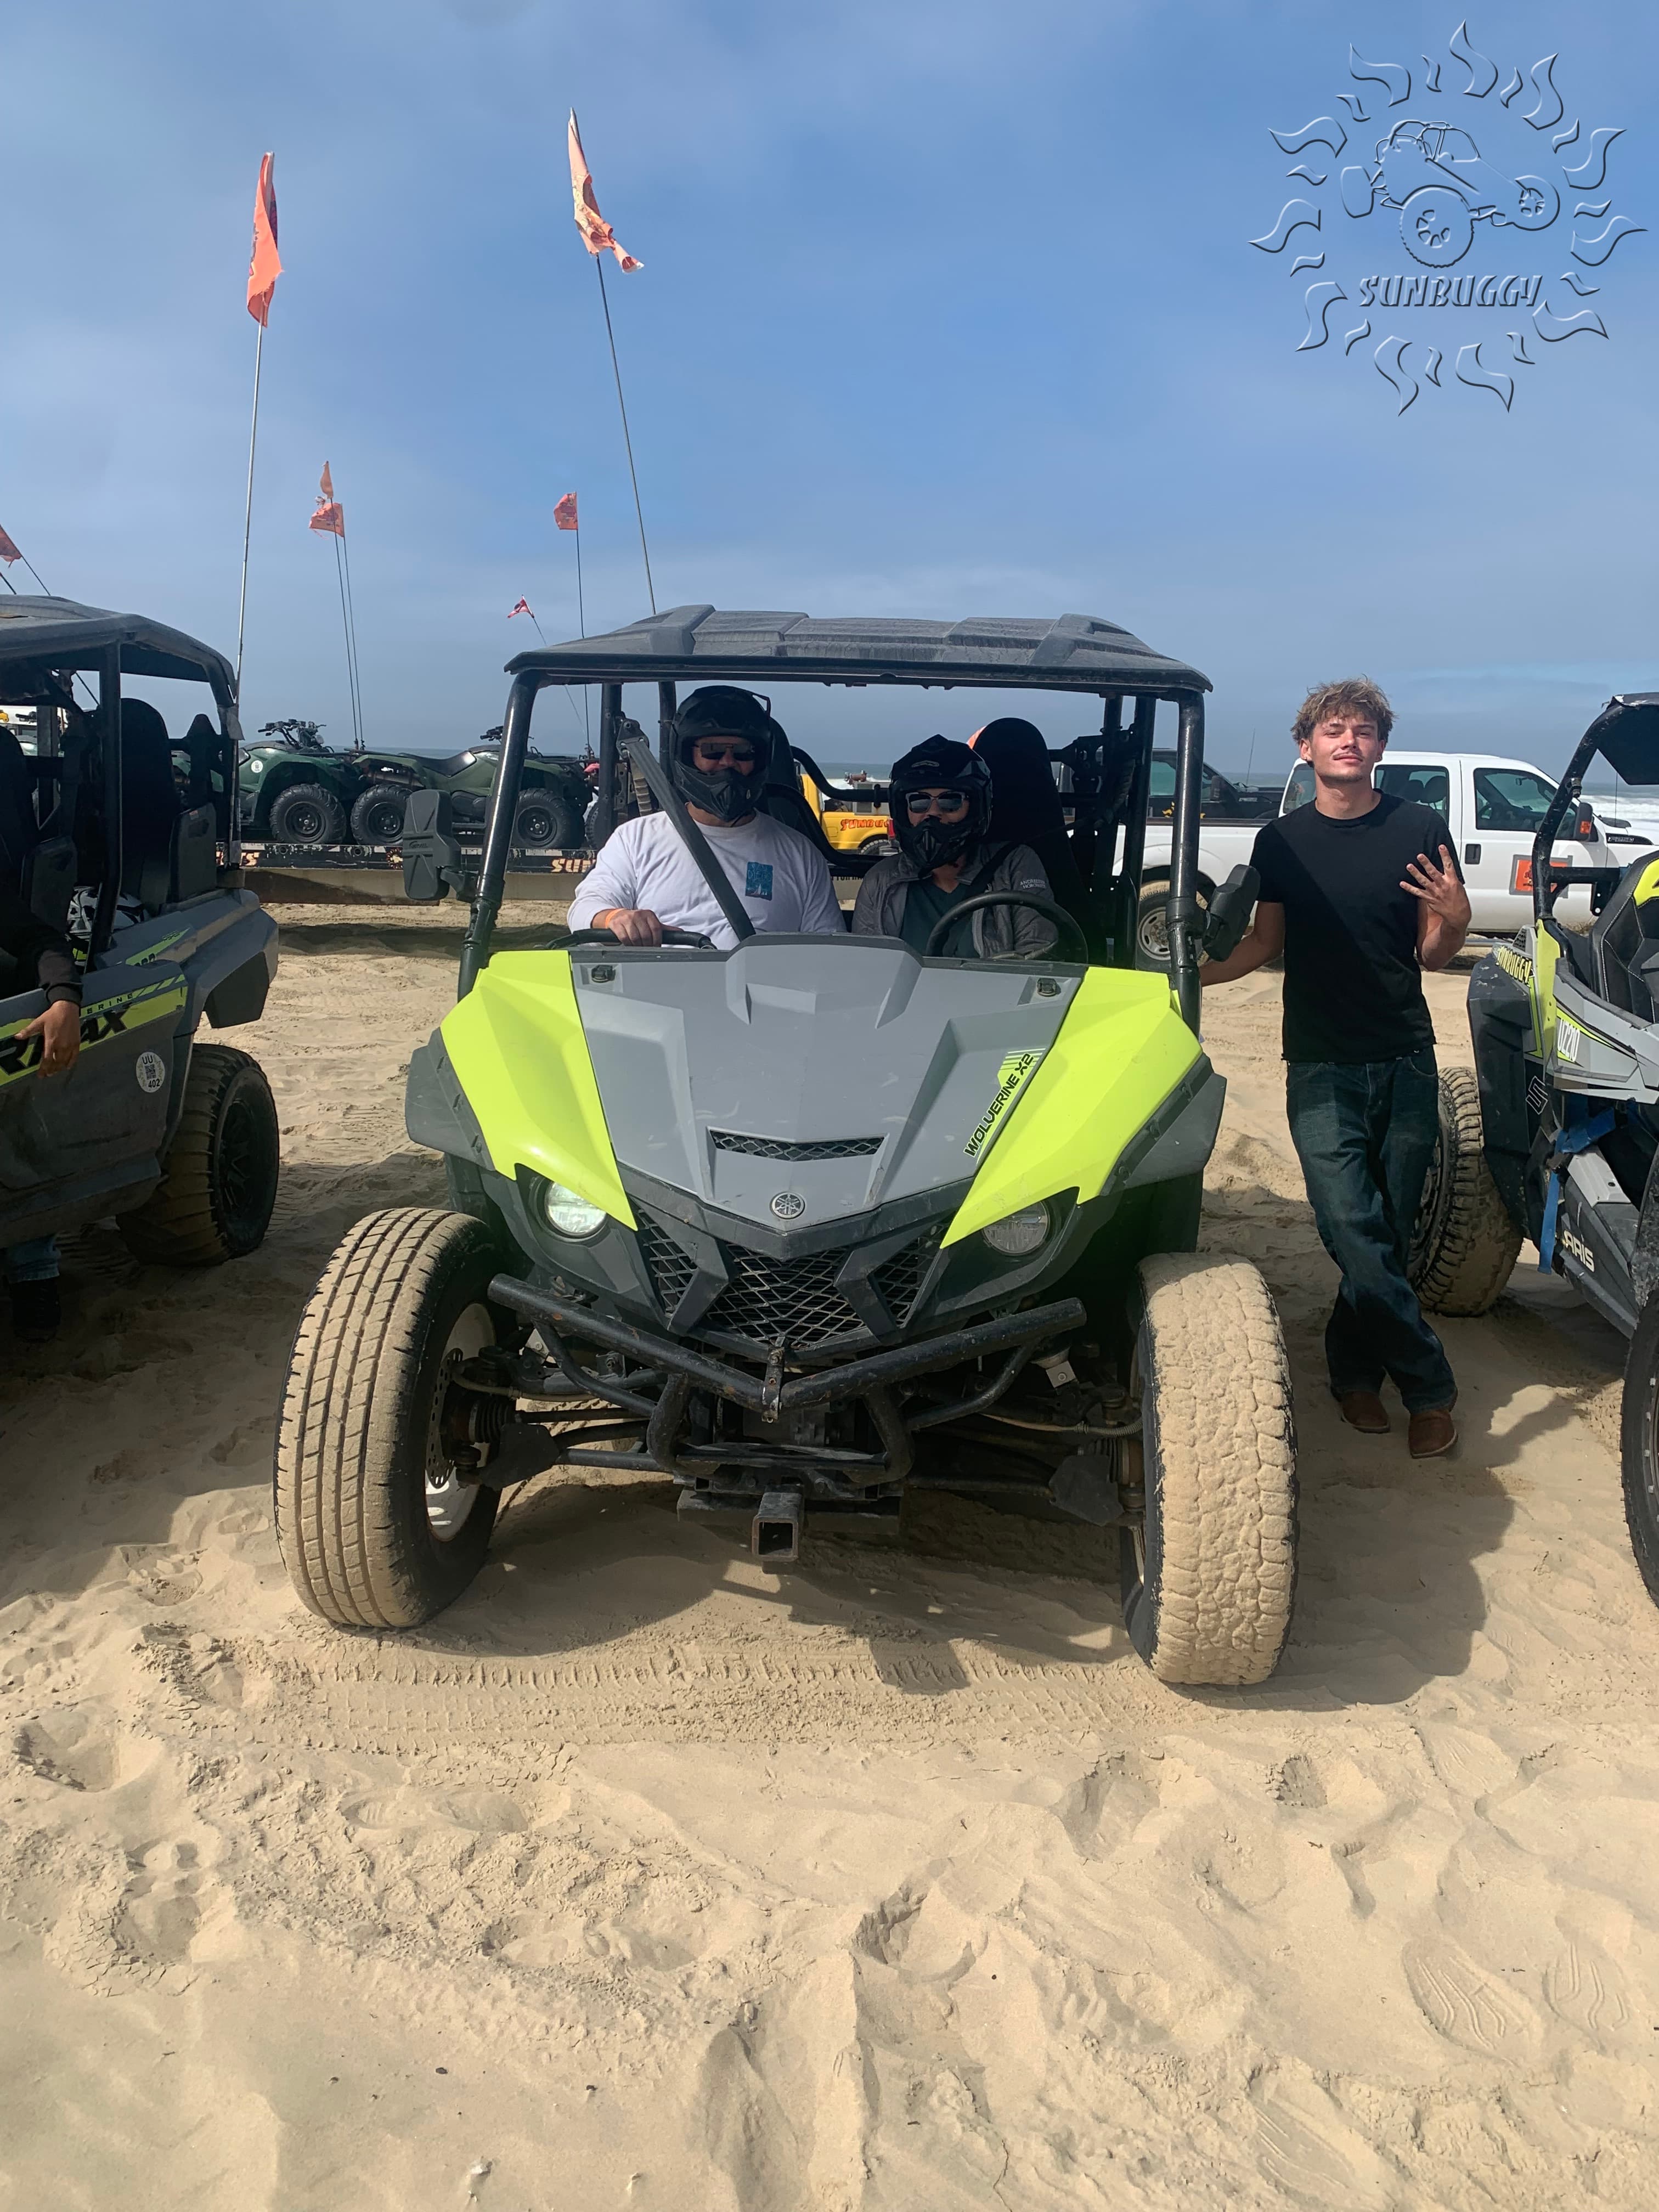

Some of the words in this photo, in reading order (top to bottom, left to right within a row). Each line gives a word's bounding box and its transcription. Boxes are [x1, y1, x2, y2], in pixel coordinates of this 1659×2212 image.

[87, 994, 133, 1014] ERINE
[1557, 1018, 1581, 1063] UZ210
[142, 1055, 153, 1064] UU
[148, 1079, 160, 1088] 402
[964, 1073, 1020, 1157] WOLVERINE
[1014, 1053, 1034, 1076] X2
[1564, 1230, 1595, 1272] ARIS
